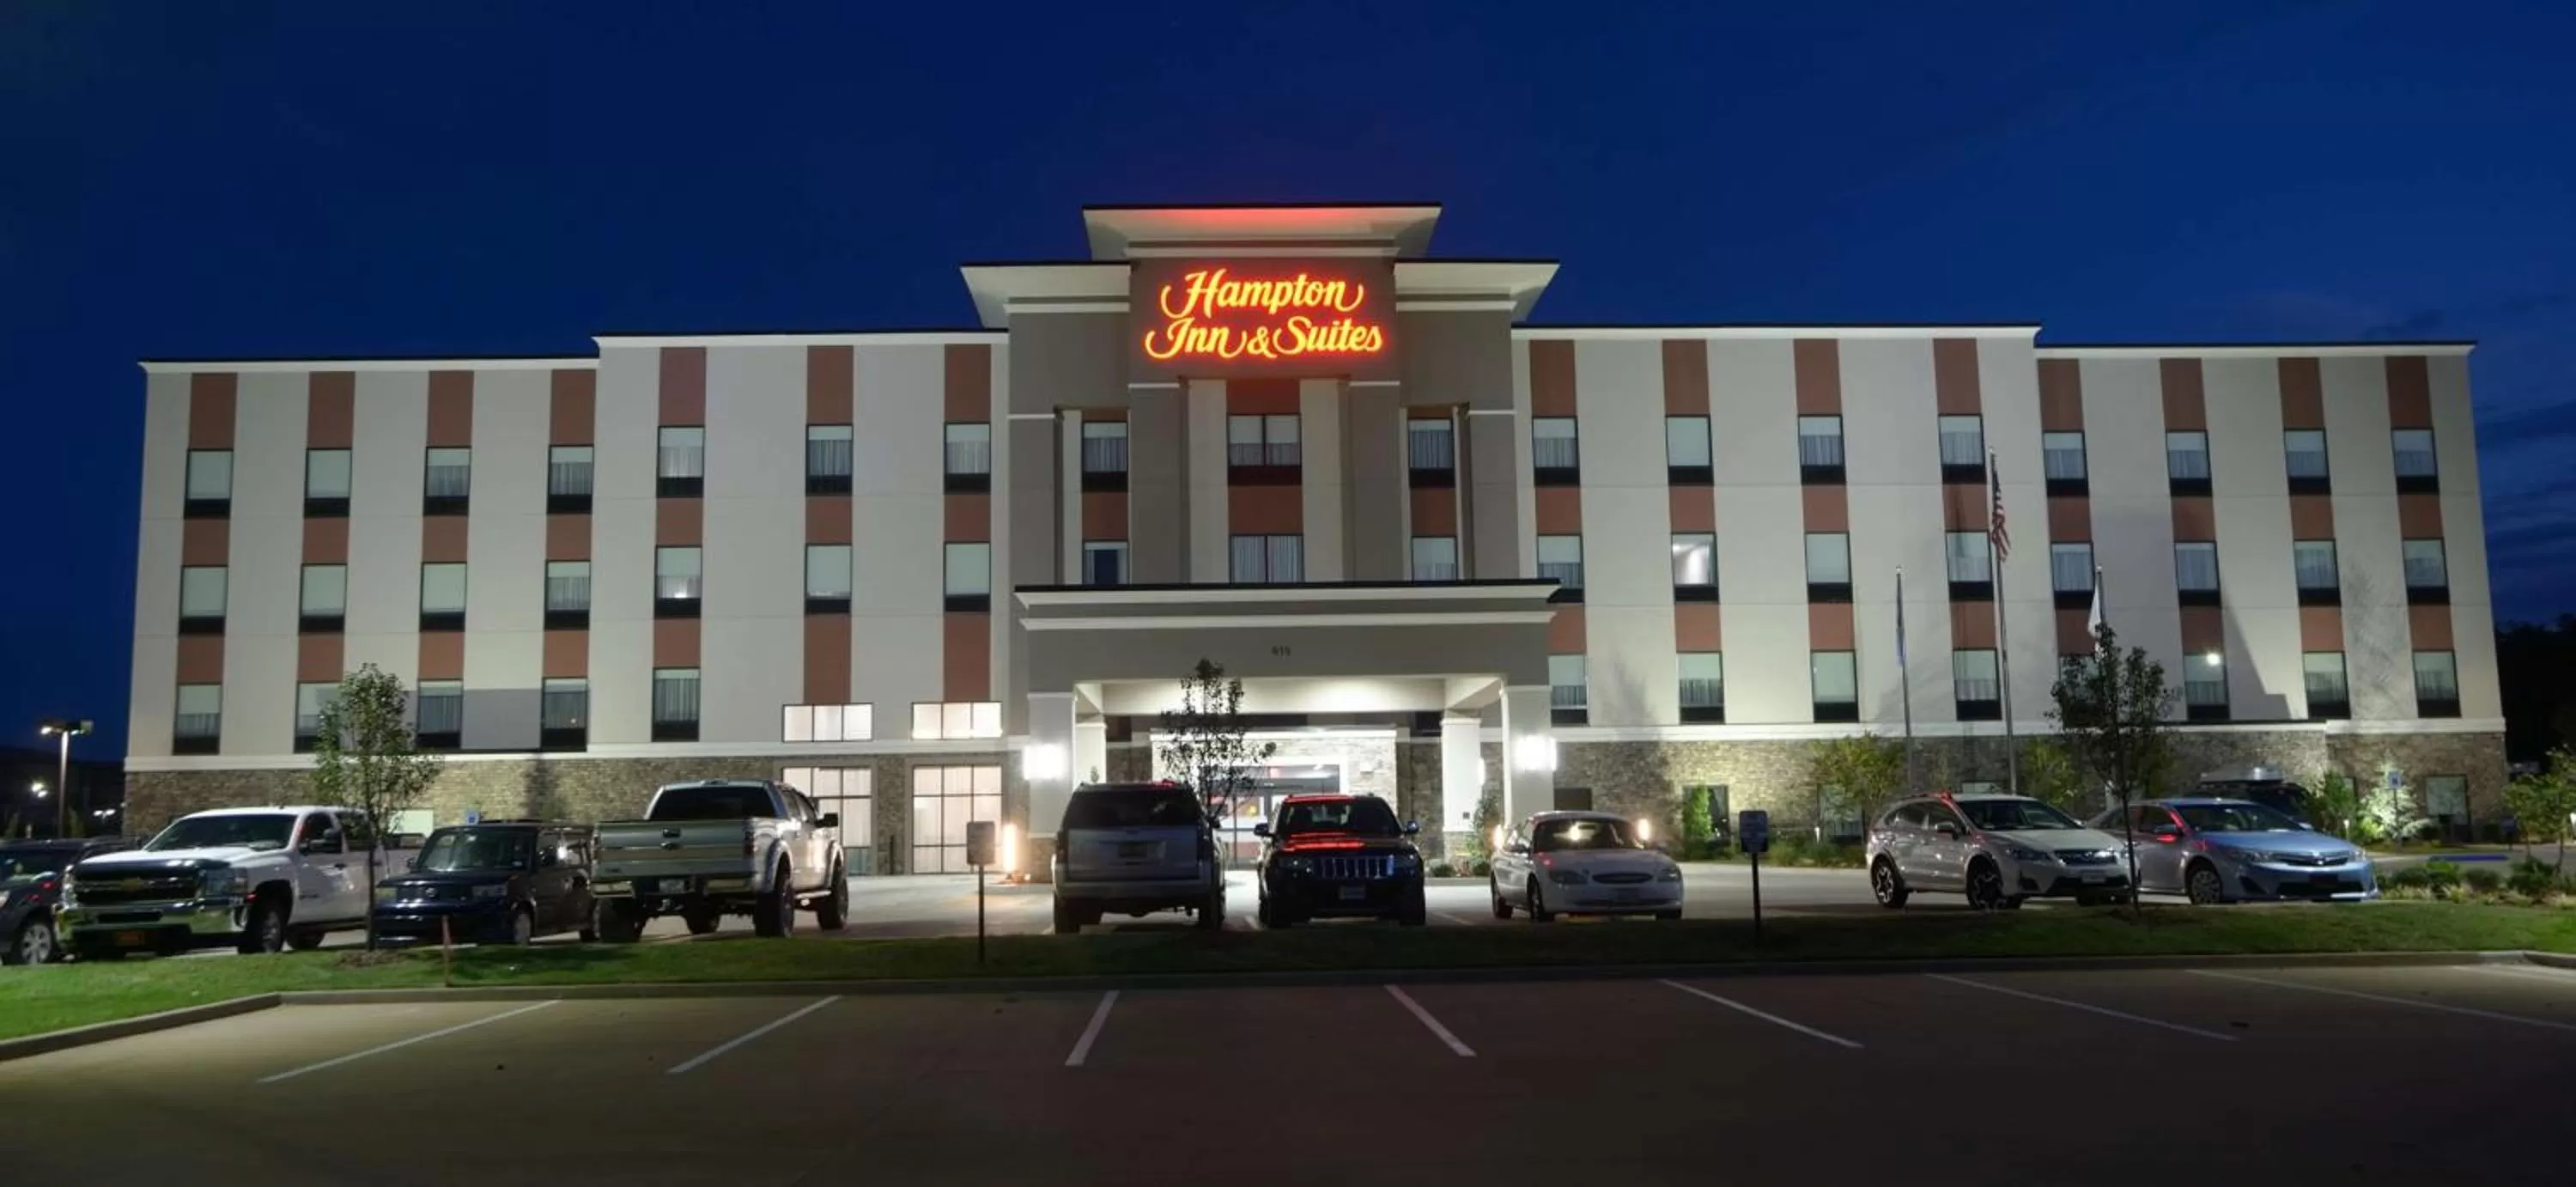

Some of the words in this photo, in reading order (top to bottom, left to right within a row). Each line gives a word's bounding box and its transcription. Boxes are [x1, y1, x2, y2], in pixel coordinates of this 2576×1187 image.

[1160, 268, 1364, 318] Hampton
[1145, 316, 1248, 358] Inn
[1247, 326, 1278, 358] &
[1272, 315, 1382, 356] Suites
